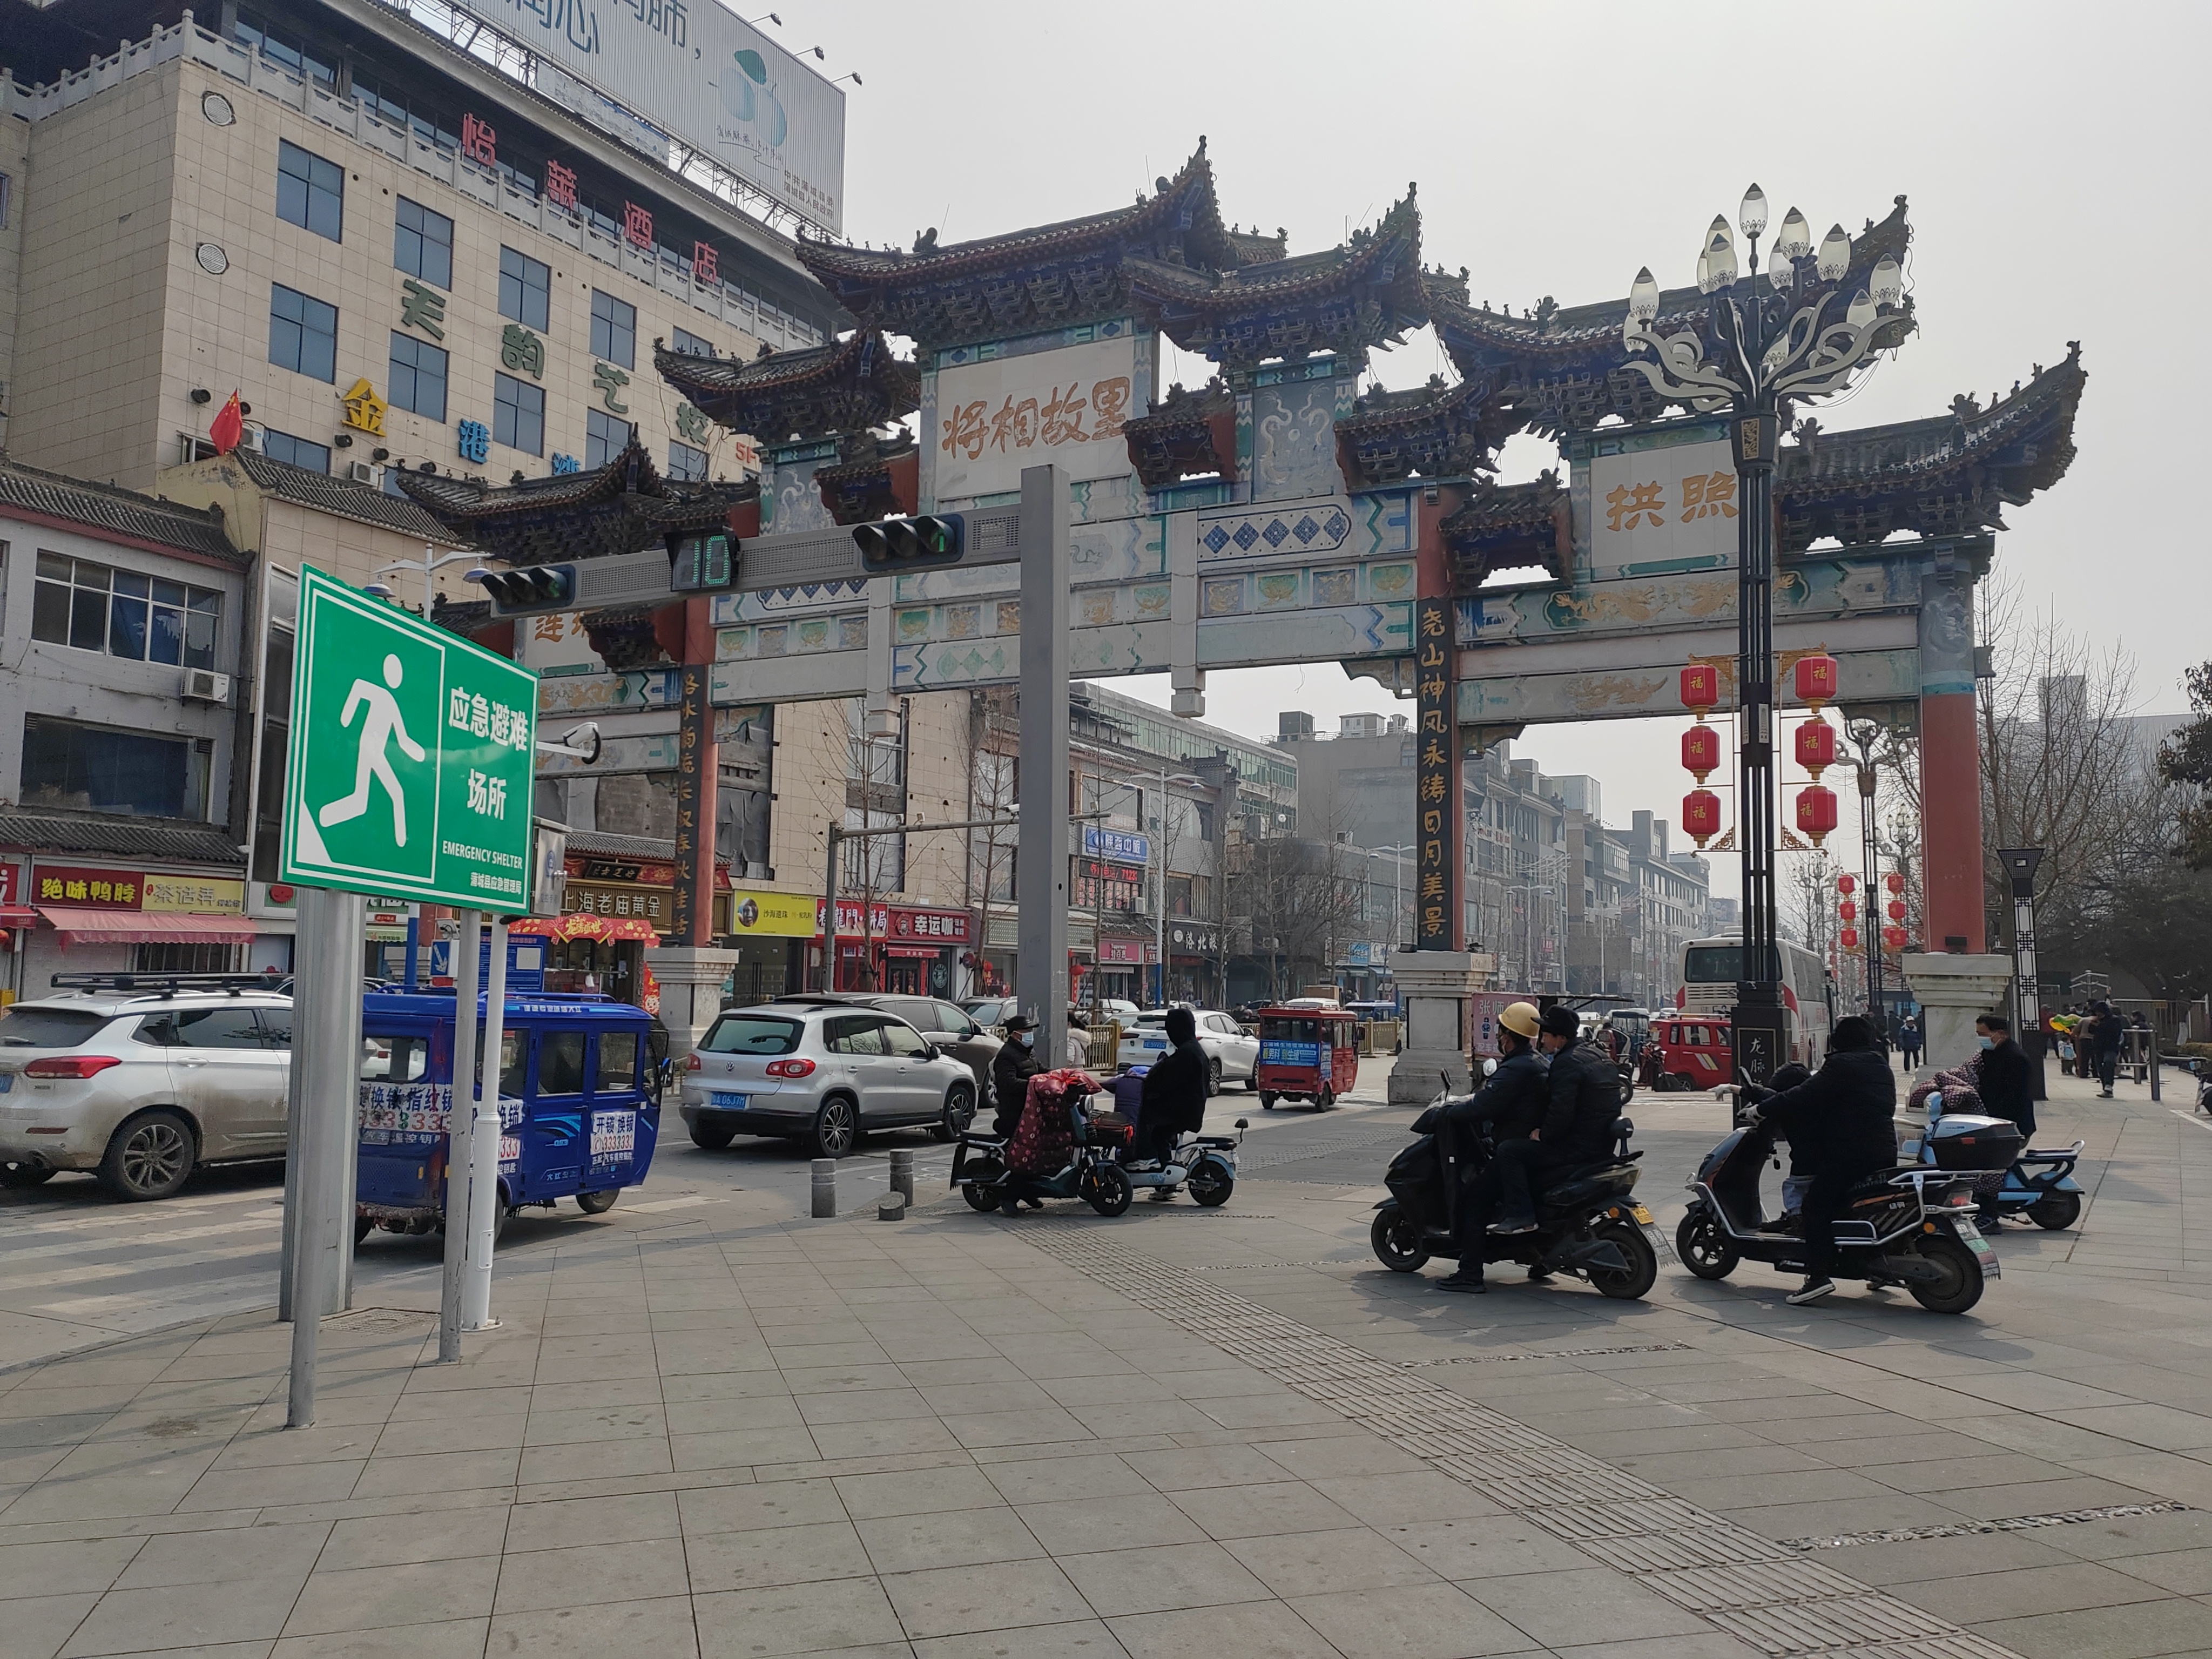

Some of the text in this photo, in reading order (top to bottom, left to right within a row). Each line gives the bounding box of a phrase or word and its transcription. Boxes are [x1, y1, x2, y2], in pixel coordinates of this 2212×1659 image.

[942, 376, 1130, 461] 将相故里
[1690, 676, 1704, 689] 福
[1813, 666, 1827, 680] 福
[448, 686, 529, 751] 应急避难
[1690, 740, 1704, 754] 福
[1804, 735, 1819, 750] 福
[467, 768, 507, 820] 场所
[1692, 805, 1707, 819] 福
[1800, 802, 1813, 817] 福
[442, 840, 523, 869] EMERGENCY SHELTER
[41, 878, 136, 903] 绝味鸭脖
[470, 872, 522, 895] 蒲城县应急管理局
[560, 890, 660, 917] 上海老庙黄金
[914, 914, 954, 936] 幸运咖
